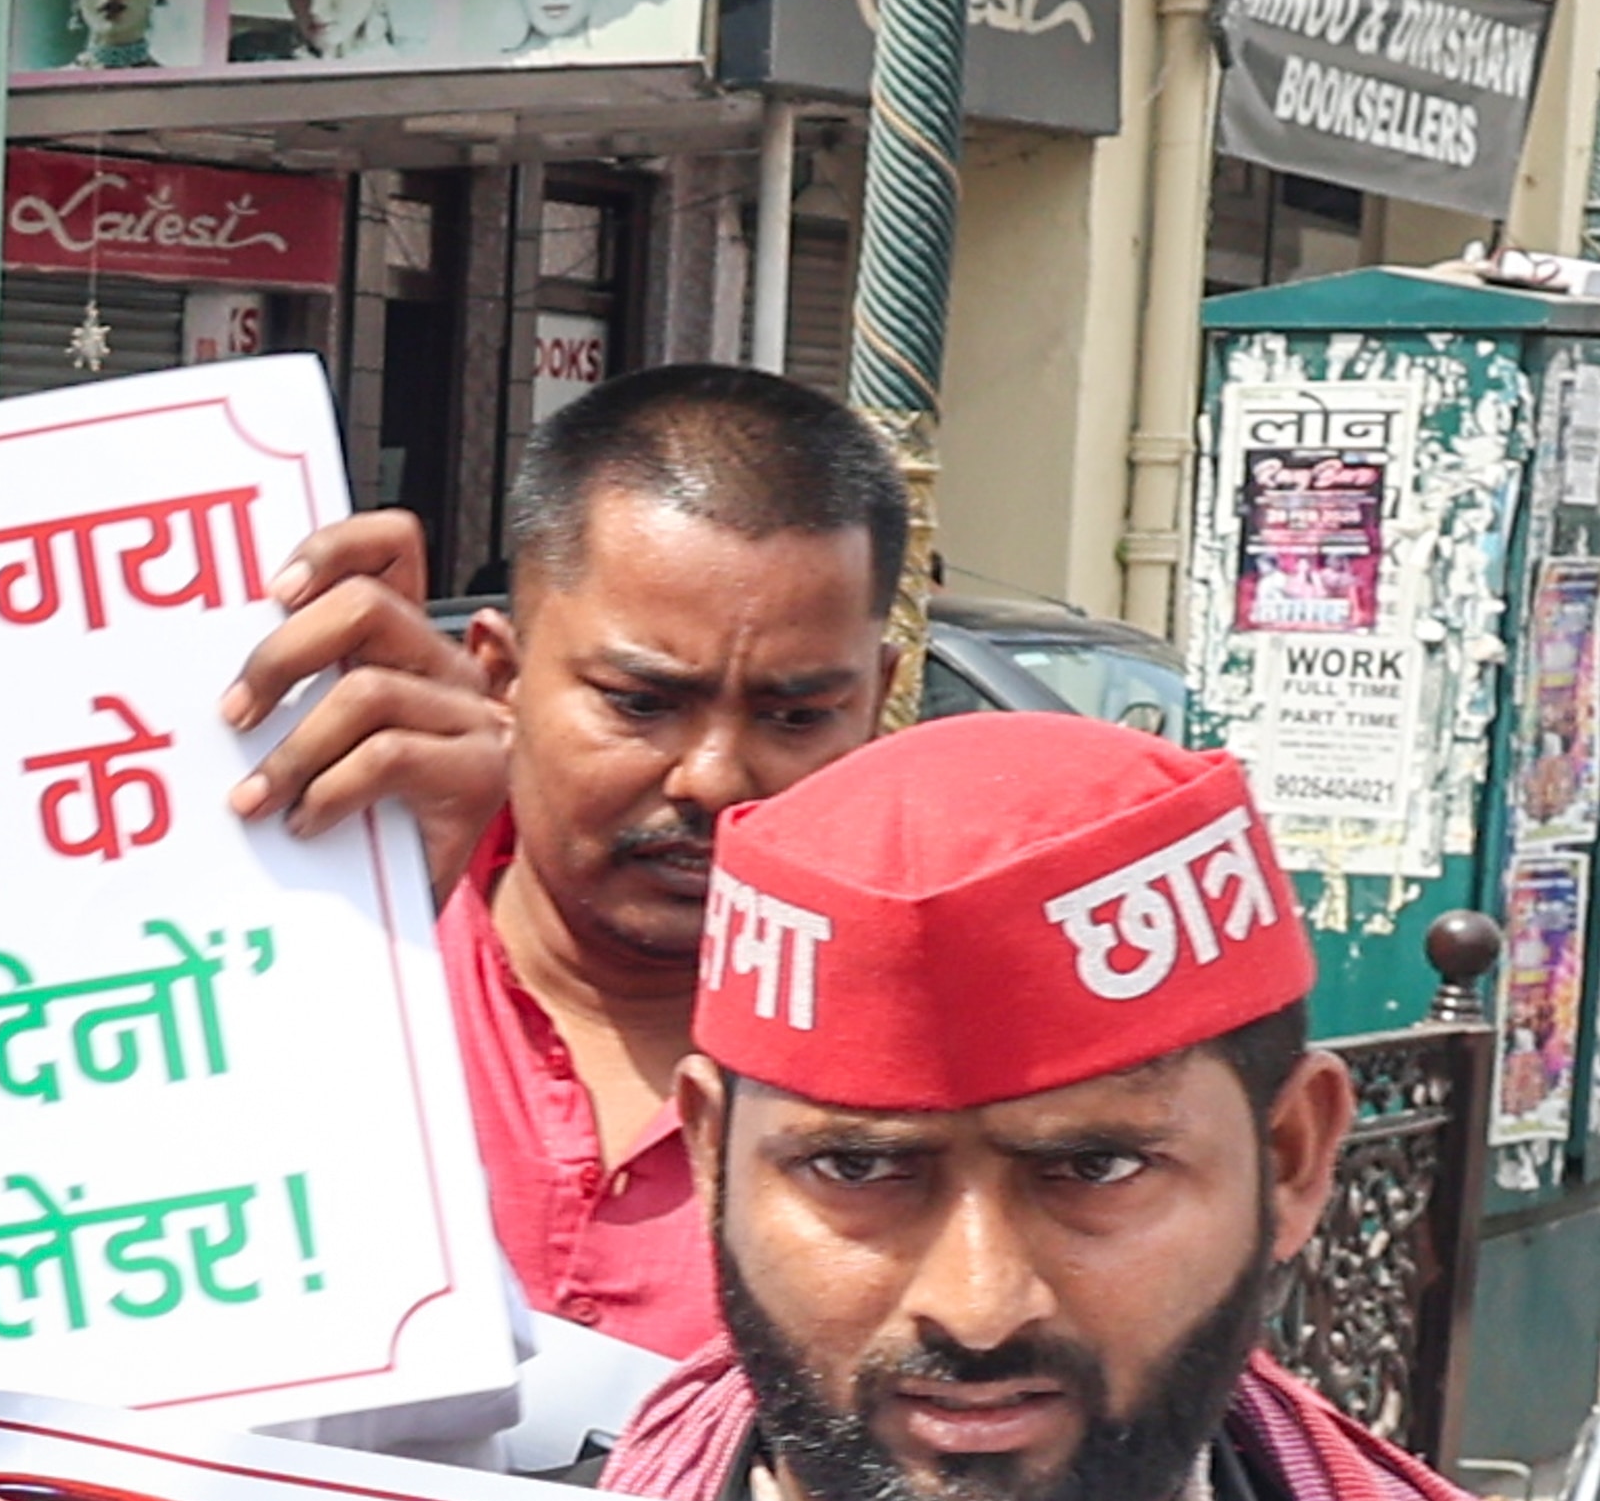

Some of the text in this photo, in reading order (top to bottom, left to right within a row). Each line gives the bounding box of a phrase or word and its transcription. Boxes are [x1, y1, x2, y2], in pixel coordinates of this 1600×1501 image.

[1273, 53, 1479, 170] BOOKSELLERS
[1243, 390, 1403, 445] लोन
[1282, 678, 1402, 699] FULL TIME
[1286, 646, 1404, 681] WORK
[1279, 708, 1400, 729] PART TIME
[23, 694, 173, 862] के
[1043, 804, 1279, 1001] छात्र
